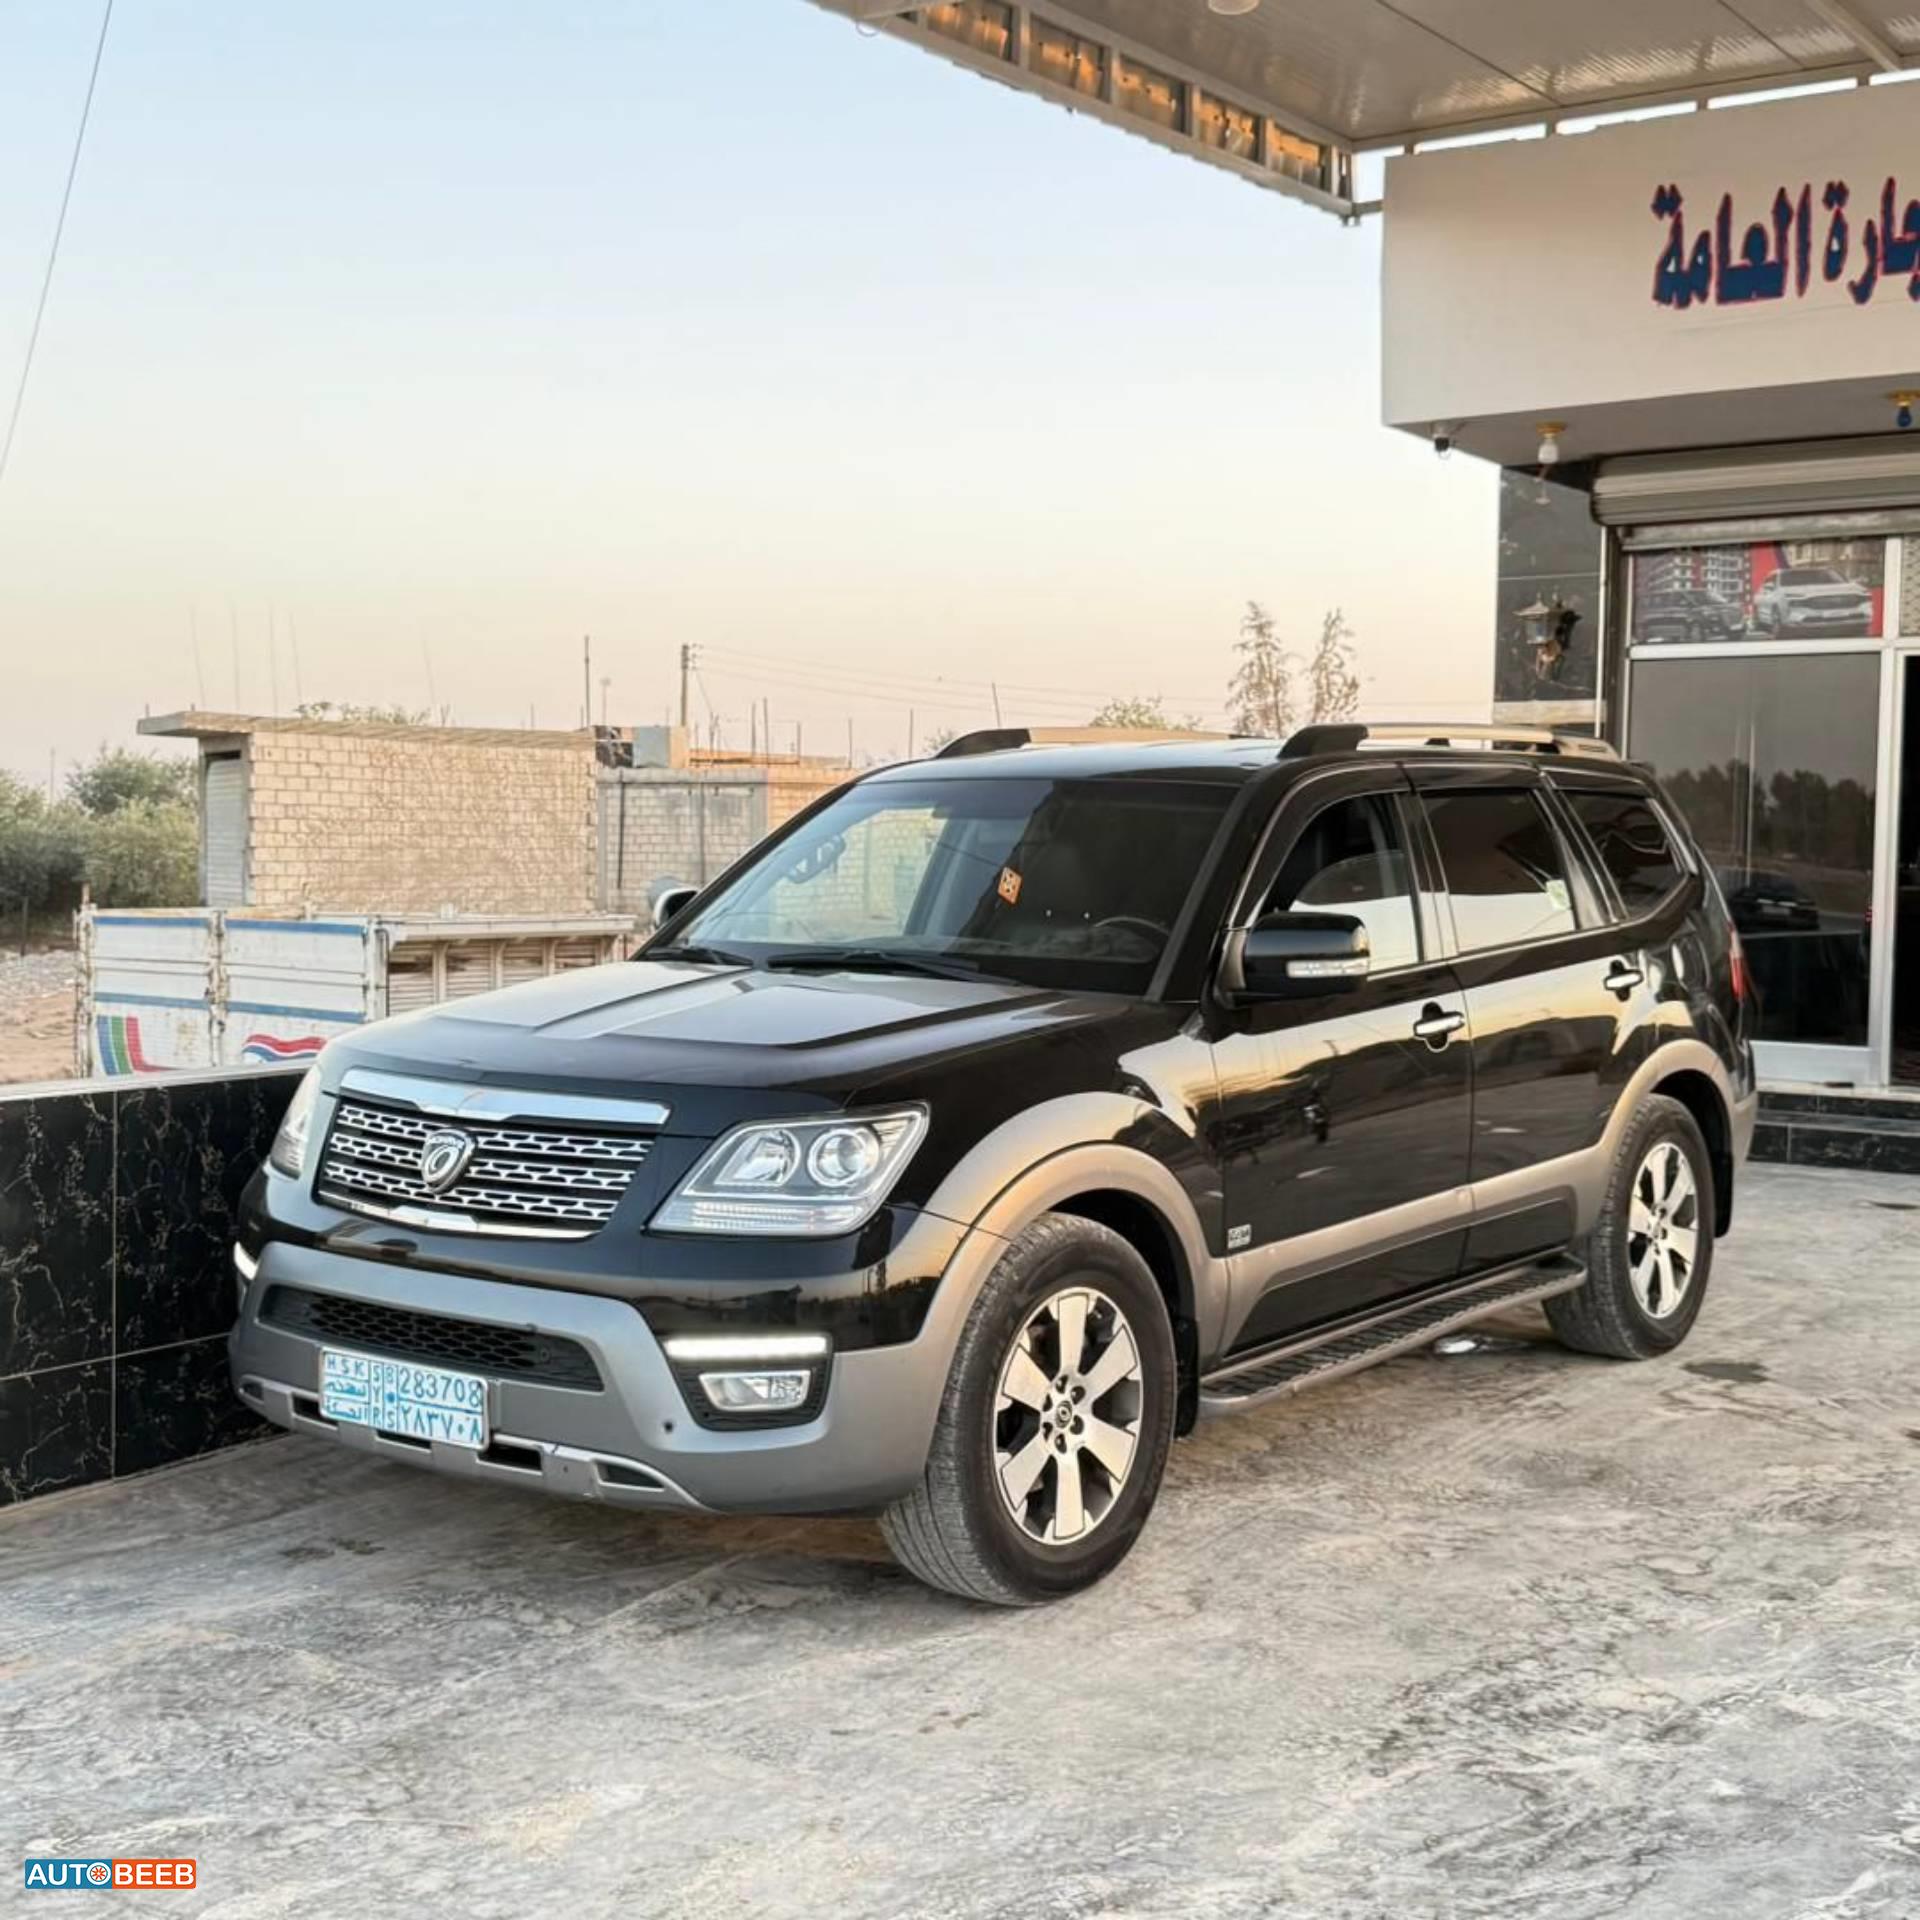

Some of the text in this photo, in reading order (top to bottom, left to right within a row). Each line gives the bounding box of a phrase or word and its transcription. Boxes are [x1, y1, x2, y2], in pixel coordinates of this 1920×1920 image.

[1651, 182, 1812, 310] العامة
[326, 1355, 365, 1377] HSK
[400, 1367, 482, 1408] 283708
[401, 1405, 482, 1441] ٢٨٣٧٠٨
